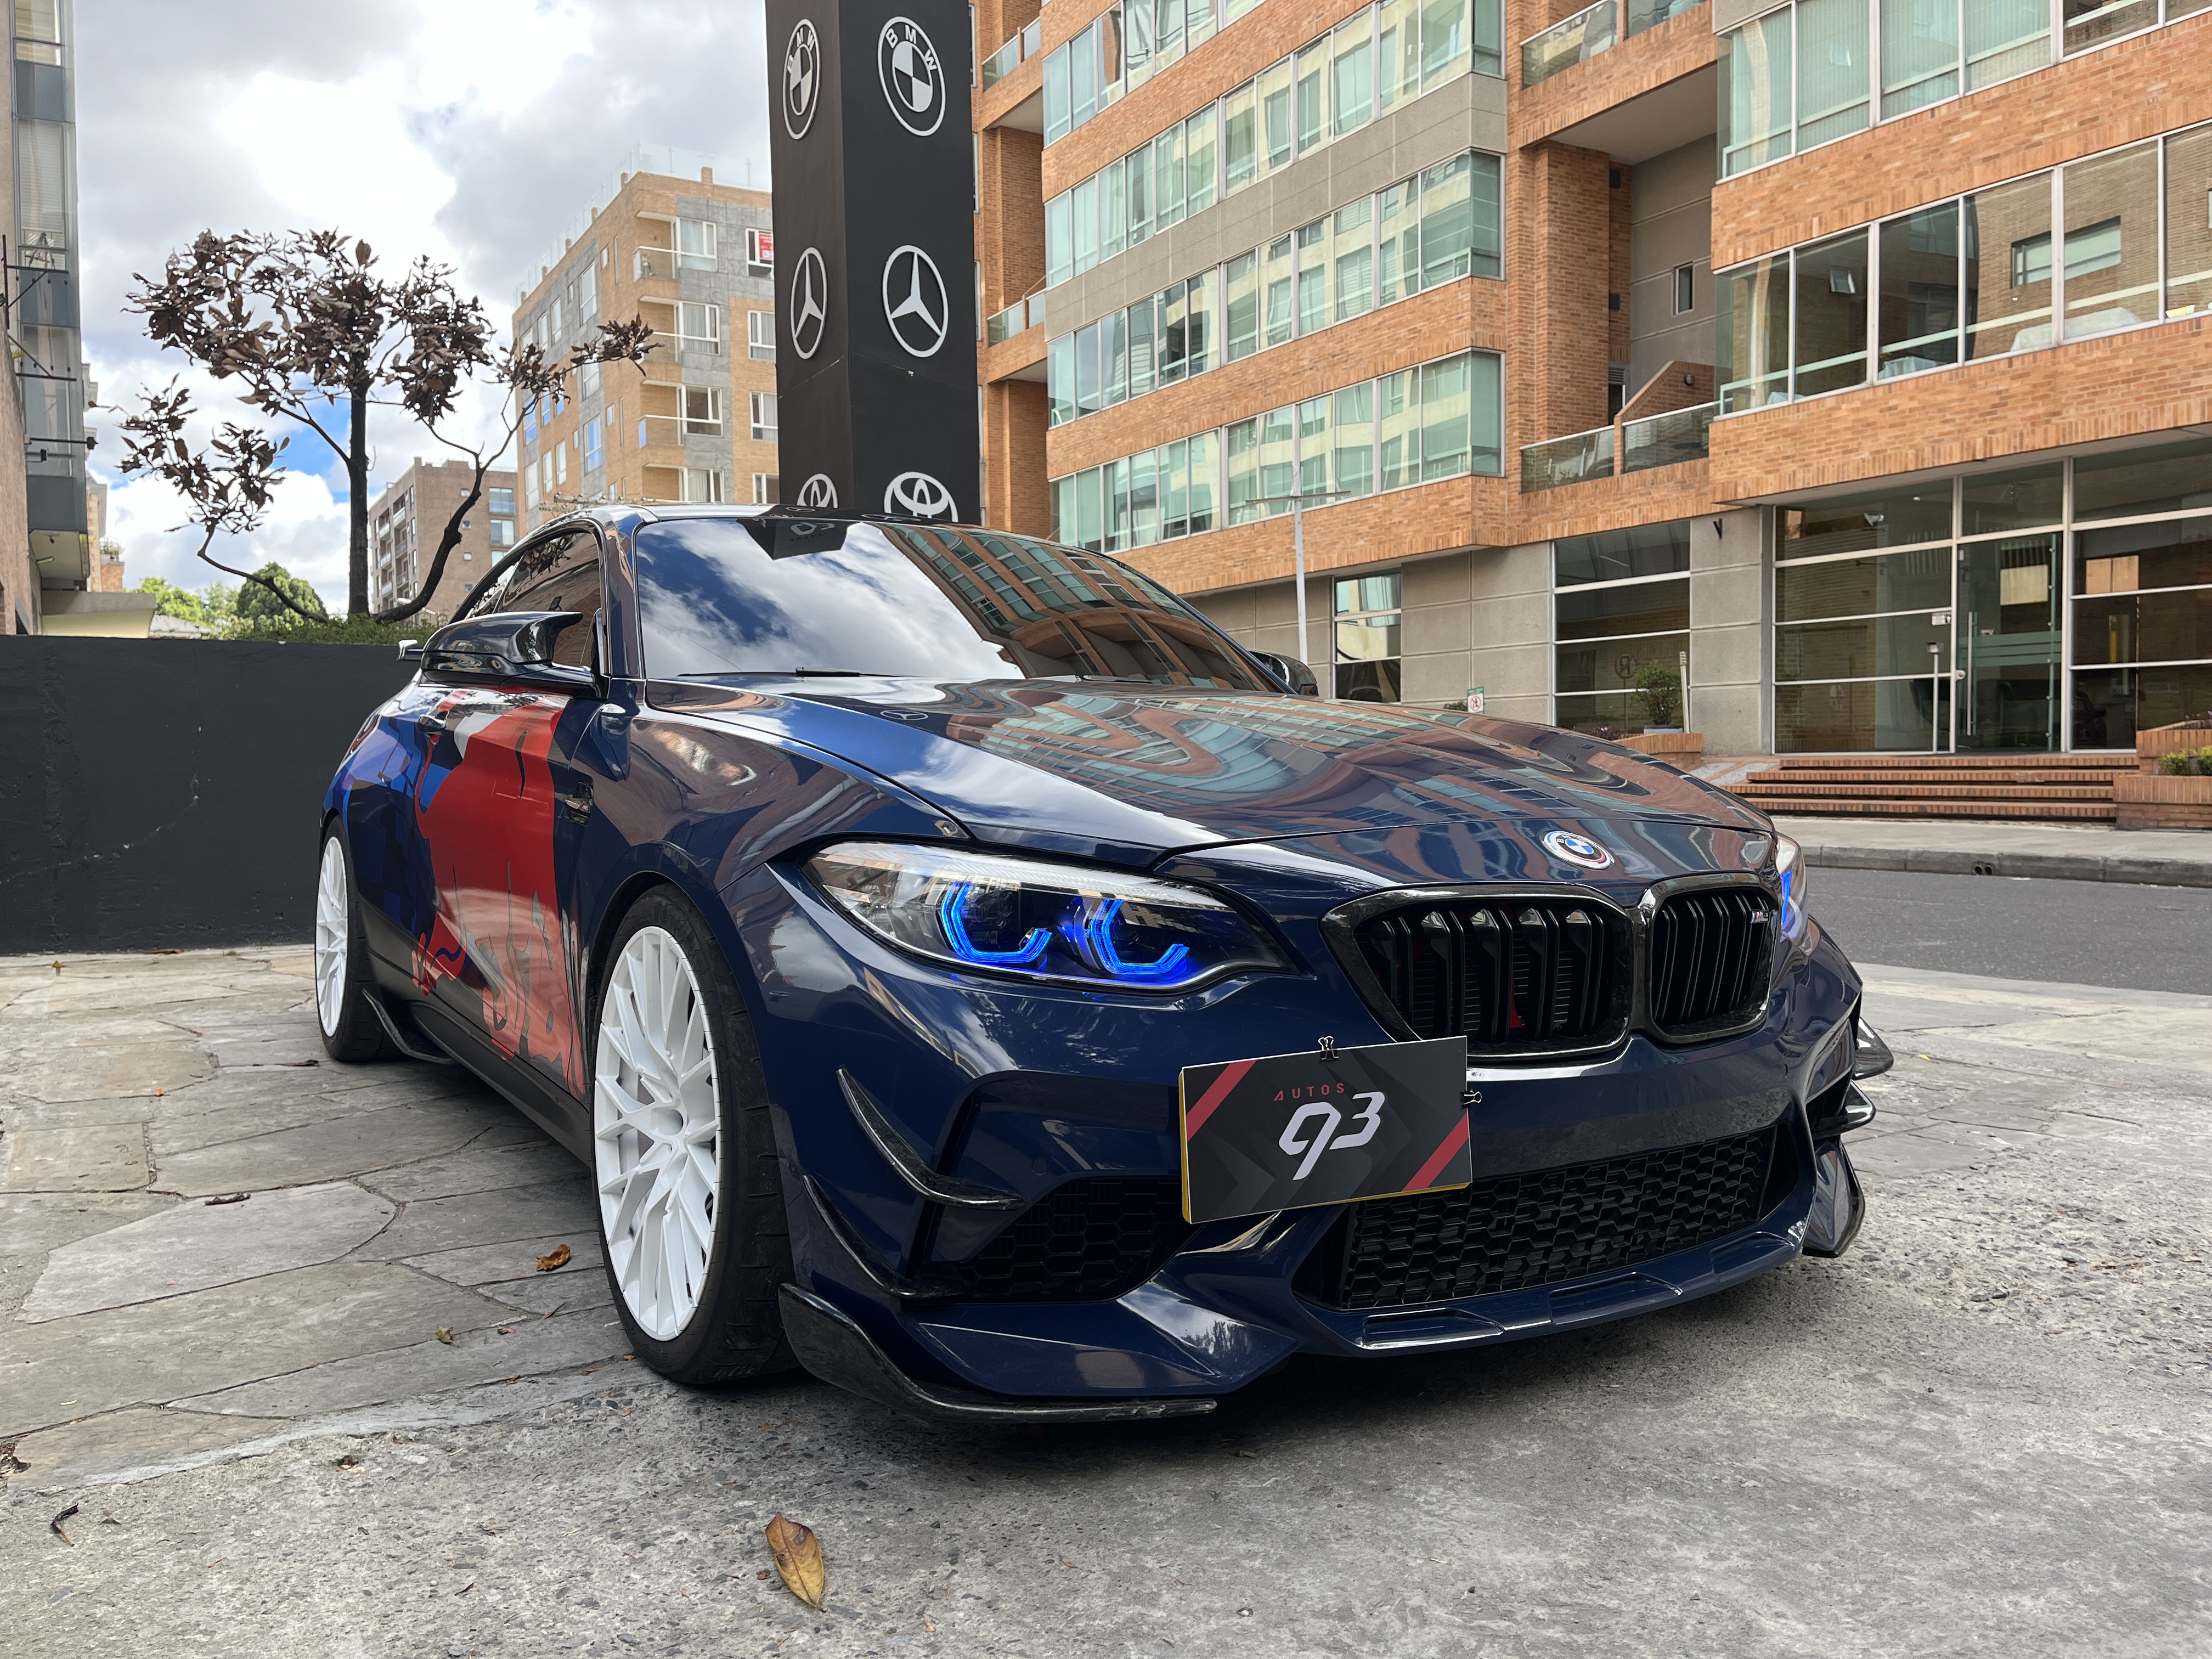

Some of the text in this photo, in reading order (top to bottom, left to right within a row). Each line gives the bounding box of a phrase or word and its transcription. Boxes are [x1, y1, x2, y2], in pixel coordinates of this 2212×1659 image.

[885, 25, 938, 70] BMW
[1273, 1082, 1345, 1102] AUTOS
[1278, 1091, 1386, 1181] 93
